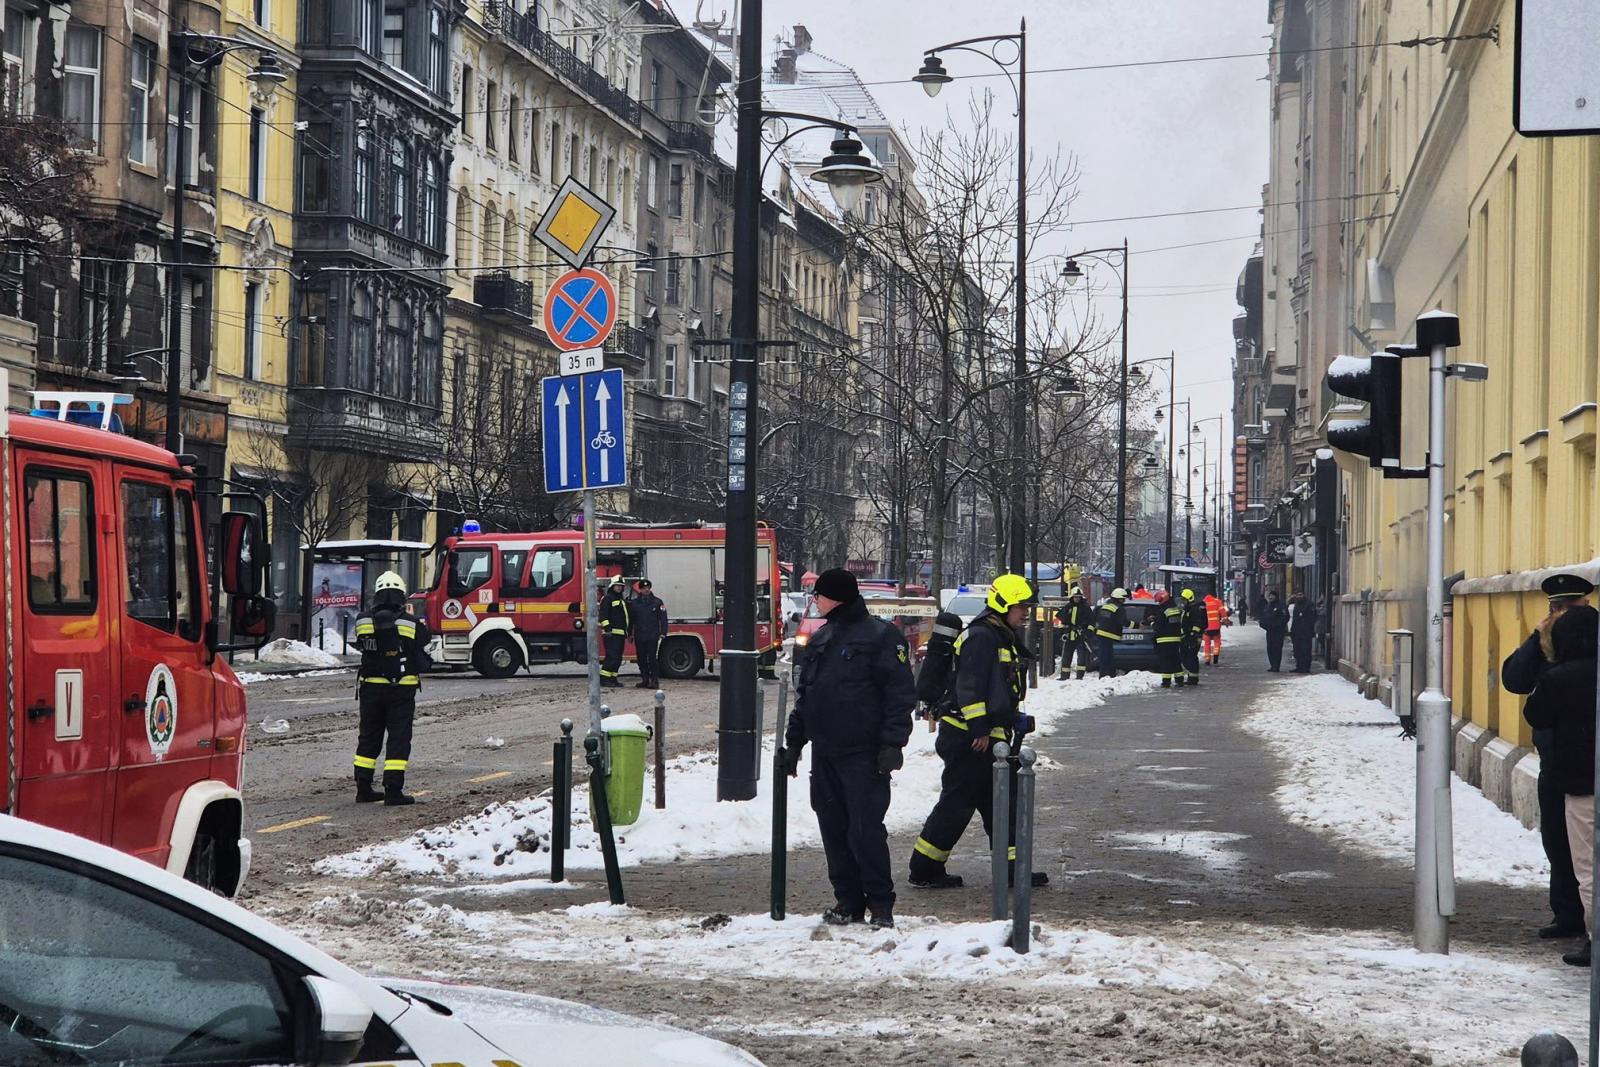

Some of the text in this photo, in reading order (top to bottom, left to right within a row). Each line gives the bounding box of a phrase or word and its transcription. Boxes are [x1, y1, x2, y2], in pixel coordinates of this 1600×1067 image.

[568, 355, 595, 370] 35 m
[600, 531, 614, 540] 112
[481, 591, 490, 602] IX
[892, 607, 921, 615] BUDAPEST
[65, 681, 73, 728] V
